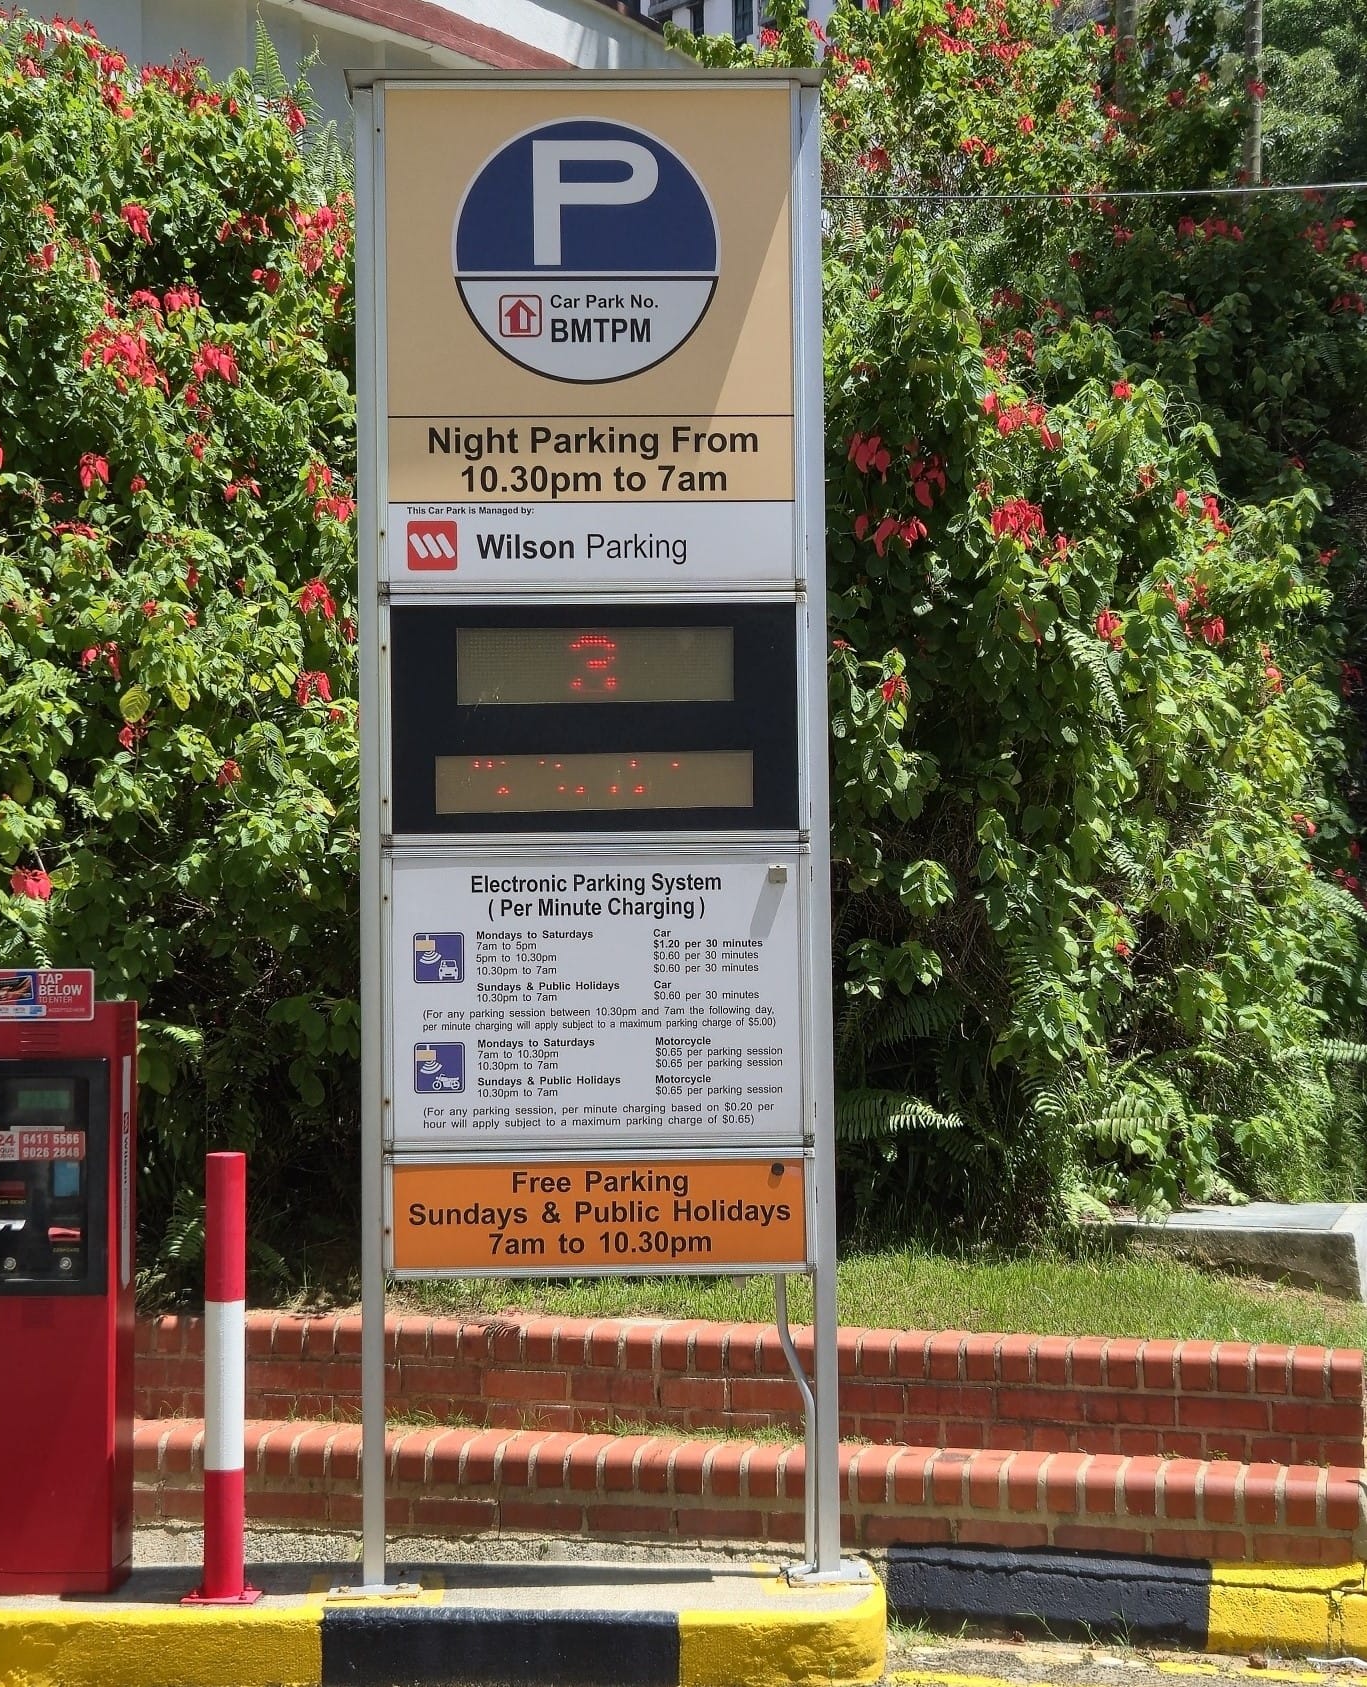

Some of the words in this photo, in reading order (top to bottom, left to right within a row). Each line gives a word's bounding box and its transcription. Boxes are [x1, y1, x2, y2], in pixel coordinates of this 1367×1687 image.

[533, 140, 658, 265] P
[551, 295, 580, 308] Car
[587, 295, 624, 308] Park
[631, 295, 658, 308] No.
[552, 319, 650, 343] BMTPM
[429, 427, 518, 461] Night
[531, 427, 658, 460] Parking
[673, 426, 758, 452] From
[462, 466, 601, 499] 10.30pm
[614, 466, 646, 492] to
[658, 465, 726, 492] 7am
[479, 507, 518, 515] Managed
[521, 507, 534, 515] by:
[477, 534, 574, 559] Wilson
[588, 534, 686, 565] Parking
[472, 875, 567, 893] Electronic
[574, 874, 645, 894] Parking
[652, 873, 721, 894] System
[539, 898, 601, 916] Minute
[477, 931, 522, 942] Mondays
[528, 931, 537, 939] to
[543, 930, 593, 941] Saturdays
[653, 929, 671, 937] Car
[477, 942, 497, 951] 7am
[502, 942, 511, 950] to
[516, 941, 536, 952] 5pm
[654, 939, 679, 949] $1.20
[685, 942, 701, 950] per
[706, 939, 717, 948] 30
[723, 939, 763, 947] minutes
[476, 954, 496, 964] 5pm
[502, 954, 510, 962] to
[516, 953, 556, 964] 10.30pm
[654, 951, 680, 961] $0.60
[685, 953, 700, 961] per
[705, 951, 716, 959] 30
[722, 950, 758, 959] minutes
[477, 966, 517, 977] 10.30pm
[536, 966, 556, 975] 7am
[38, 973, 63, 985] TAP
[654, 981, 671, 989] Car
[38, 985, 83, 996] BELOW
[477, 983, 521, 993] Sundays
[527, 982, 534, 991] &
[539, 982, 570, 990] Public
[576, 981, 619, 992] Holidays
[38, 996, 48, 1004] TO
[48, 996, 73, 1004] ENTER
[654, 991, 680, 1000] $0.60
[686, 993, 701, 1002] per
[706, 991, 717, 999] 30
[722, 990, 759, 999] minutes
[423, 1010, 443, 1021] (For
[448, 1012, 464, 1020] any
[470, 1009, 504, 1020] parking
[509, 1008, 545, 1017] session
[551, 1008, 590, 1017] between
[596, 1007, 636, 1018] 10.30pm
[641, 1007, 659, 1015] and
[665, 1007, 685, 1015] 7am
[690, 1006, 704, 1014] the
[709, 1006, 750, 1017] following
[423, 1024, 437, 1032] per
[442, 1022, 471, 1031] minute
[475, 1021, 512, 1032] charging
[517, 1021, 530, 1029] will
[535, 1021, 558, 1031] apply
[563, 1020, 593, 1031] subject
[598, 1020, 606, 1028] to
[620, 1020, 662, 1028] maximum
[666, 1019, 697, 1029] parking
[702, 1019, 732, 1028] charge
[749, 1018, 776, 1028] $5.00)
[478, 1039, 523, 1050] Mondays
[529, 1039, 538, 1047] to
[544, 1038, 594, 1049] Saturdays
[656, 1037, 711, 1048] Motorcycle
[478, 1050, 498, 1059] 7am
[504, 1050, 512, 1059] to
[518, 1049, 558, 1060] 10.30pm
[656, 1047, 682, 1057] $0.65
[687, 1047, 703, 1058] per
[708, 1047, 742, 1059] parking
[747, 1047, 782, 1056] session
[478, 1077, 522, 1088] Sundays
[527, 1077, 534, 1085] &
[540, 1076, 571, 1085] Public
[577, 1076, 620, 1086] Holidays
[656, 1075, 711, 1085] Motorcycle
[656, 1086, 682, 1096] $0.65
[688, 1088, 703, 1096] per
[708, 1085, 742, 1096] parking
[747, 1085, 782, 1094] session
[424, 1107, 444, 1118] (For
[450, 1109, 467, 1118] any
[473, 1106, 510, 1117] parking
[562, 1107, 578, 1116] per
[584, 1105, 617, 1114] minute
[623, 1104, 665, 1115] charging
[672, 1103, 701, 1112] based
[725, 1103, 752, 1113] $0.20
[758, 1104, 774, 1112] per
[424, 1120, 446, 1128] hour
[451, 1119, 467, 1128] will
[473, 1119, 499, 1130] apply
[505, 1118, 541, 1129] subject
[546, 1118, 555, 1126] to
[573, 1117, 620, 1126] maximum
[627, 1117, 662, 1127] parking
[668, 1116, 702, 1127] charge
[708, 1116, 716, 1124] of
[723, 1116, 754, 1125] $0.65)
[513, 1171, 571, 1193] Free
[586, 1170, 688, 1197] Parking
[409, 1202, 527, 1231] Sundays
[542, 1201, 560, 1224] &
[576, 1200, 659, 1223] Public
[674, 1199, 790, 1228] Holidays
[489, 1233, 544, 1255] 7am
[559, 1233, 584, 1254] to
[600, 1231, 711, 1257] 10.30pm
